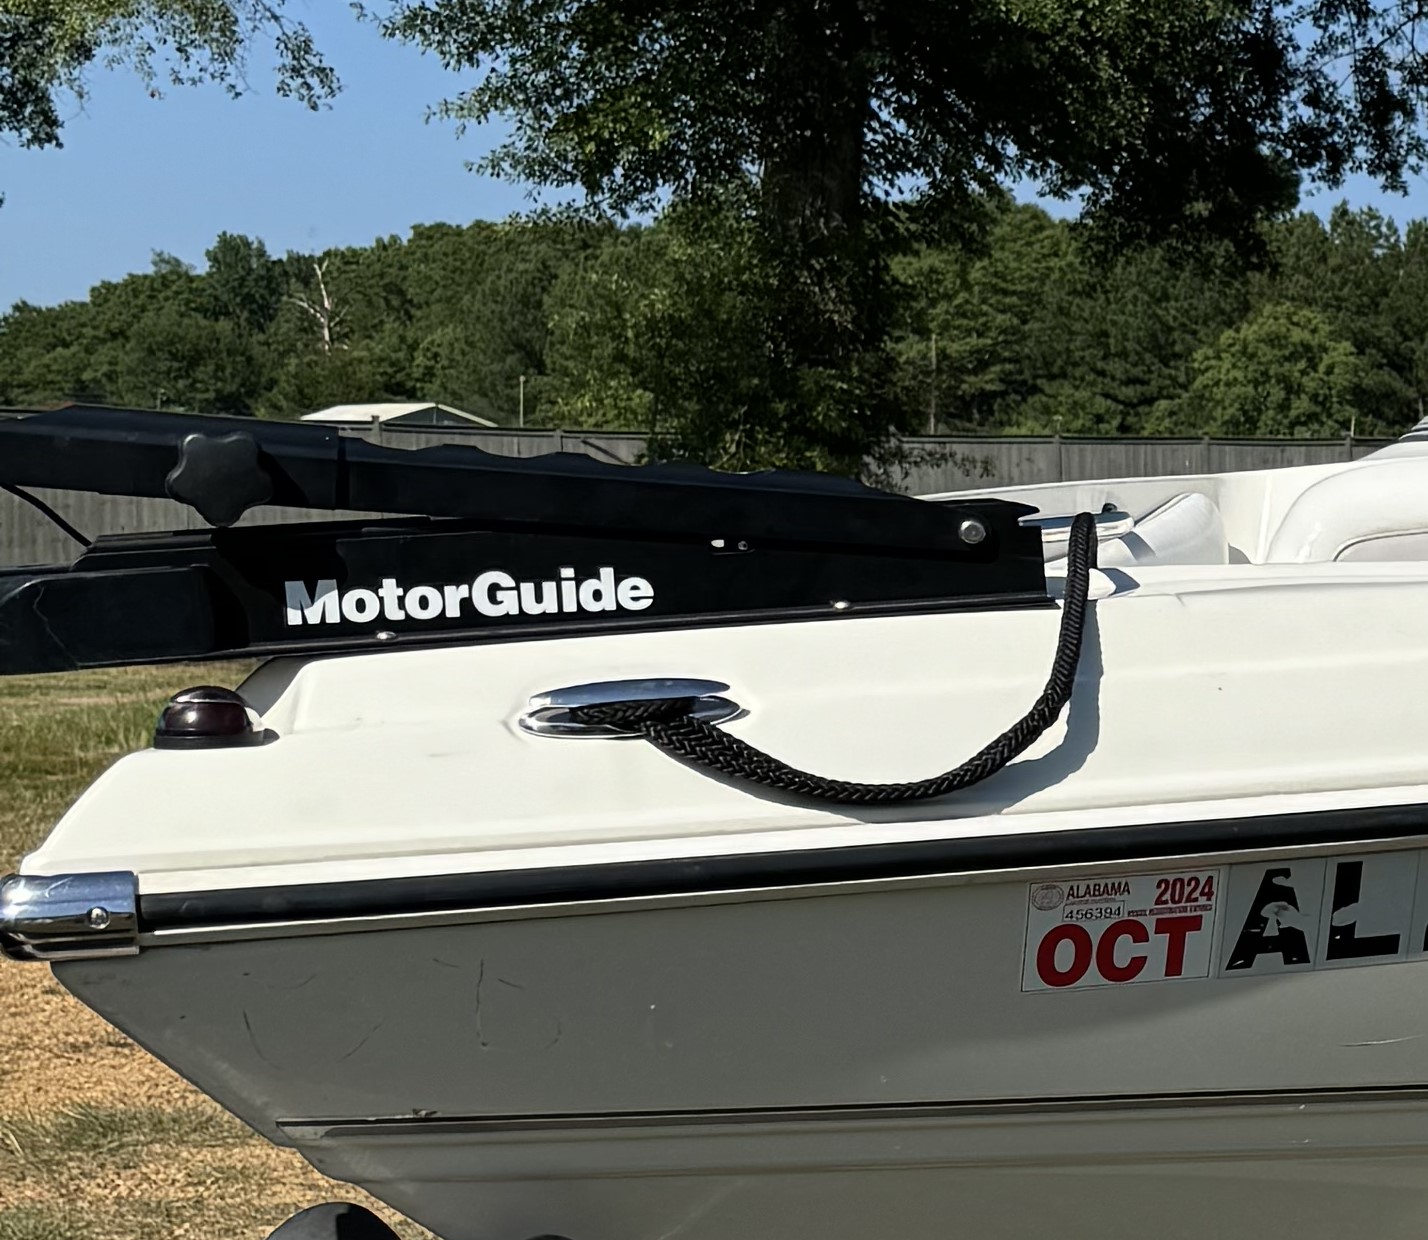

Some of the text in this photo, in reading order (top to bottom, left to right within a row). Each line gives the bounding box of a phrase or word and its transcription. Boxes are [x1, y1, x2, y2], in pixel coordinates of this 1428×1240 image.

[285, 566, 656, 627] MotorGuide
[1066, 881, 1131, 899] ALABAMA
[1154, 876, 1215, 905] 2024
[1064, 905, 1122, 921] 456394
[1036, 915, 1204, 988] OCT
